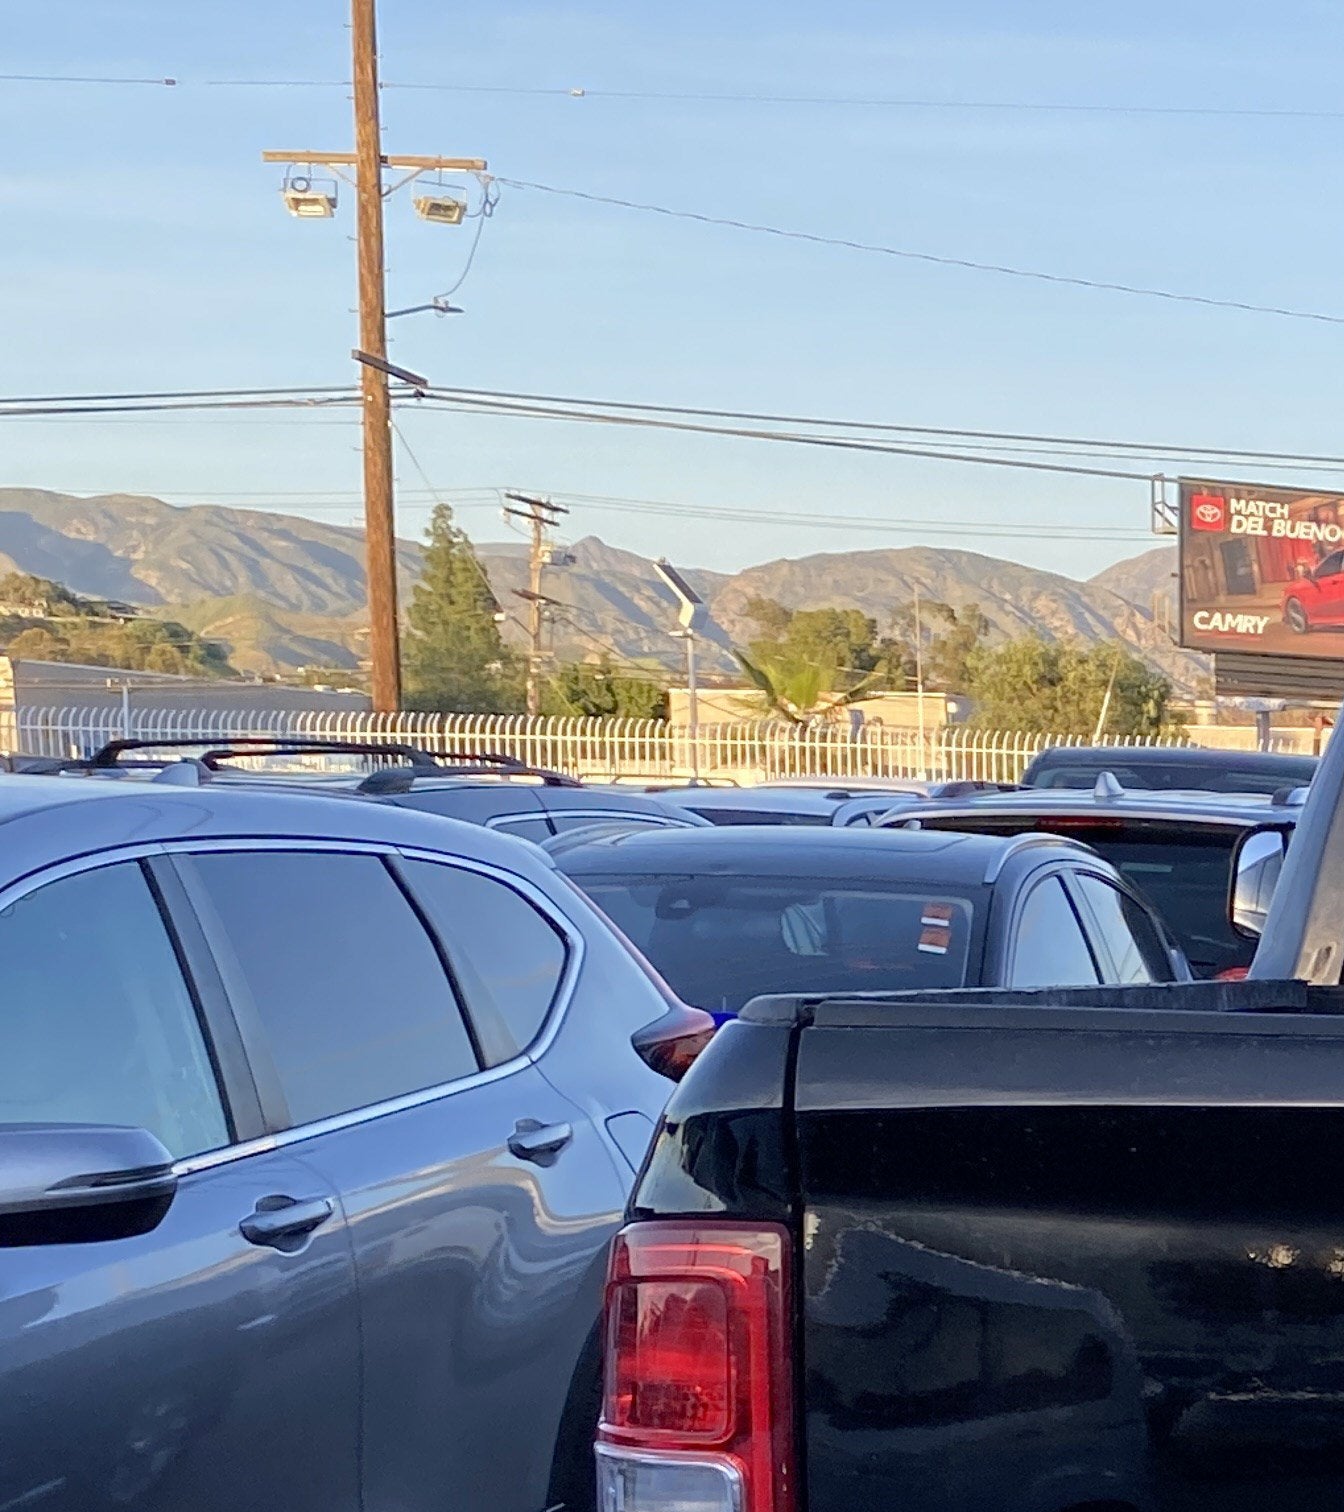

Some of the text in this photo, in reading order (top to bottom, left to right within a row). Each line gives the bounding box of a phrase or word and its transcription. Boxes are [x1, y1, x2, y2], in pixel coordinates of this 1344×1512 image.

[1230, 498, 1289, 518] MATCH
[1231, 516, 1342, 542] DEL BUENO
[1193, 611, 1270, 634] CAMRY
